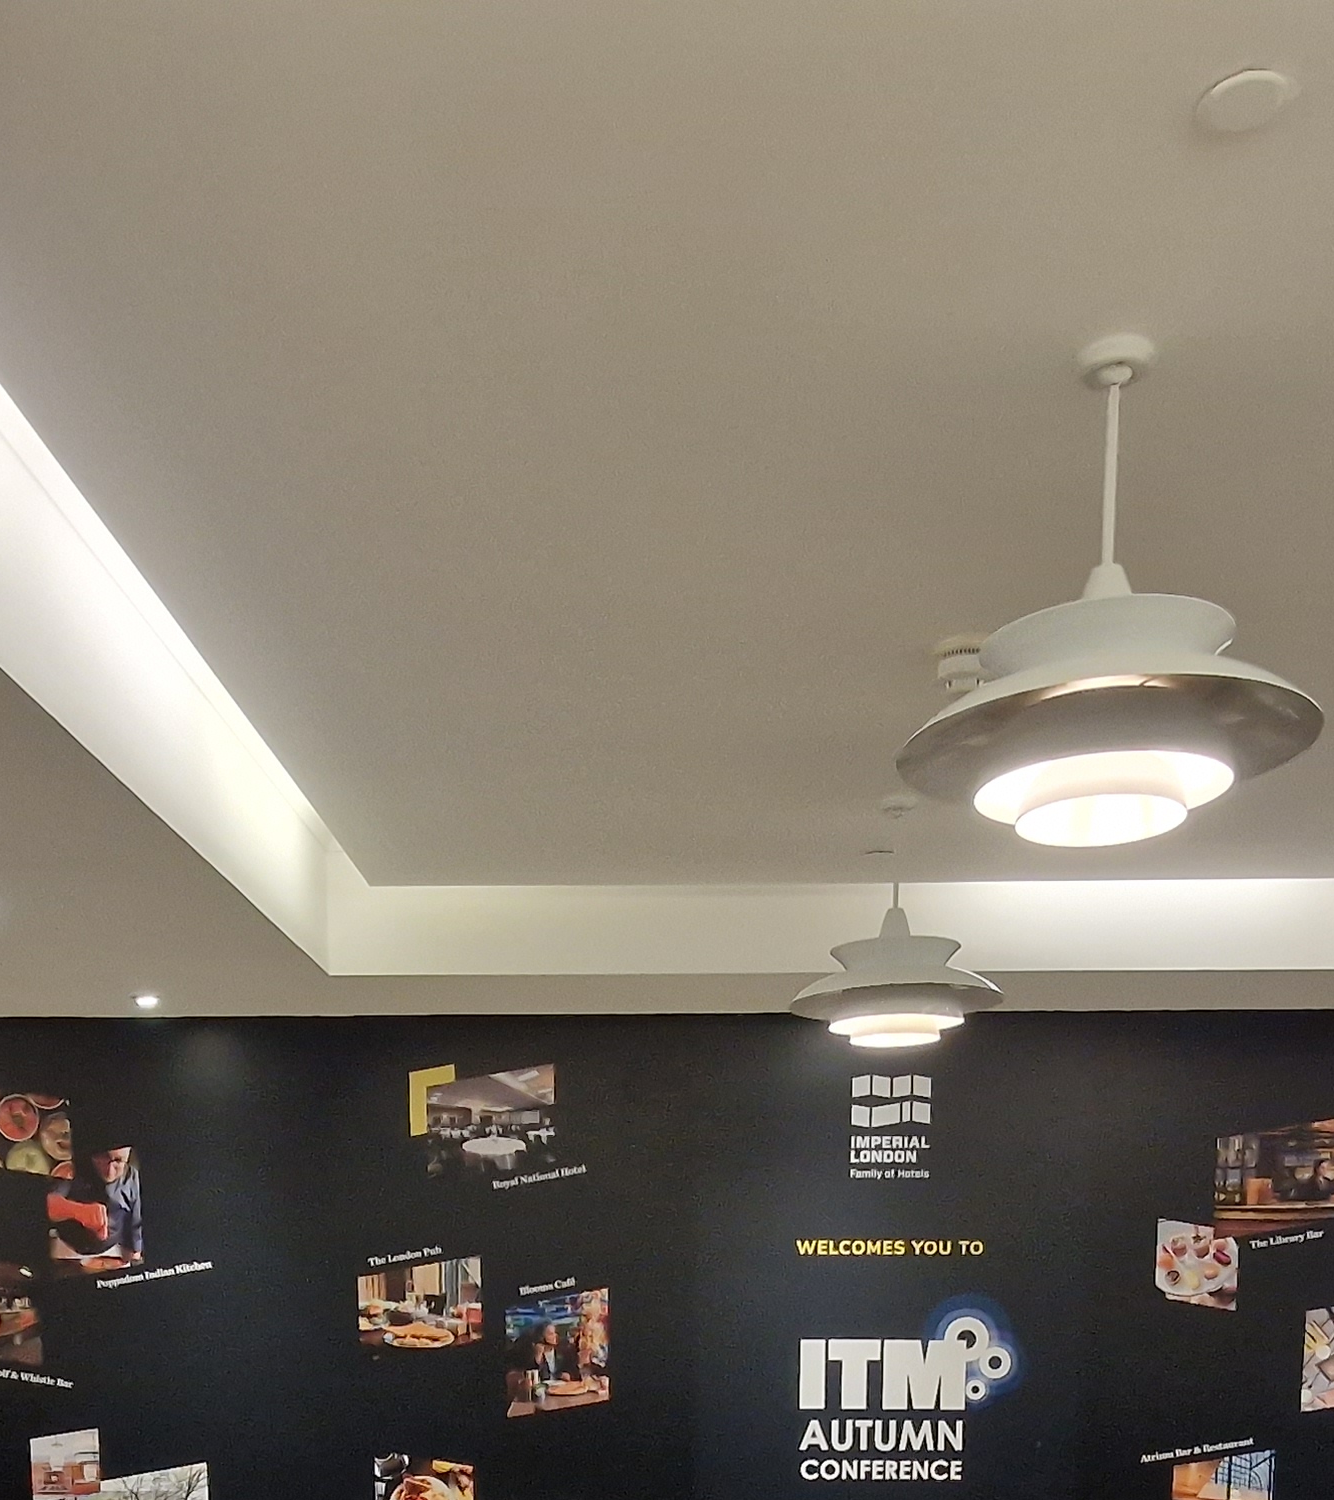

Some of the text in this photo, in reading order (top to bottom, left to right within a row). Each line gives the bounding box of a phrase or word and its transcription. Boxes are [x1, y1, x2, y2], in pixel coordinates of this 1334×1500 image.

[850, 1135, 931, 1149] IMPERIAL
[849, 1149, 917, 1164] LONDON
[519, 1168, 560, 1185] National
[560, 1163, 587, 1177] Hotel
[849, 1168, 930, 1180] Family of Hotels
[796, 1239, 984, 1256] WELCOMES YOU TO
[1249, 1239, 1269, 1250] The
[367, 1245, 443, 1267] The London Pub
[175, 1260, 213, 1274] Kitchen
[20, 1371, 56, 1386] Whistle
[56, 1378, 74, 1389] Bar
[799, 1338, 967, 1411] ITM
[798, 1419, 964, 1452] AUTUMN
[1203, 1437, 1255, 1453] Restaurant
[799, 1458, 964, 1481] CONFERENCE
